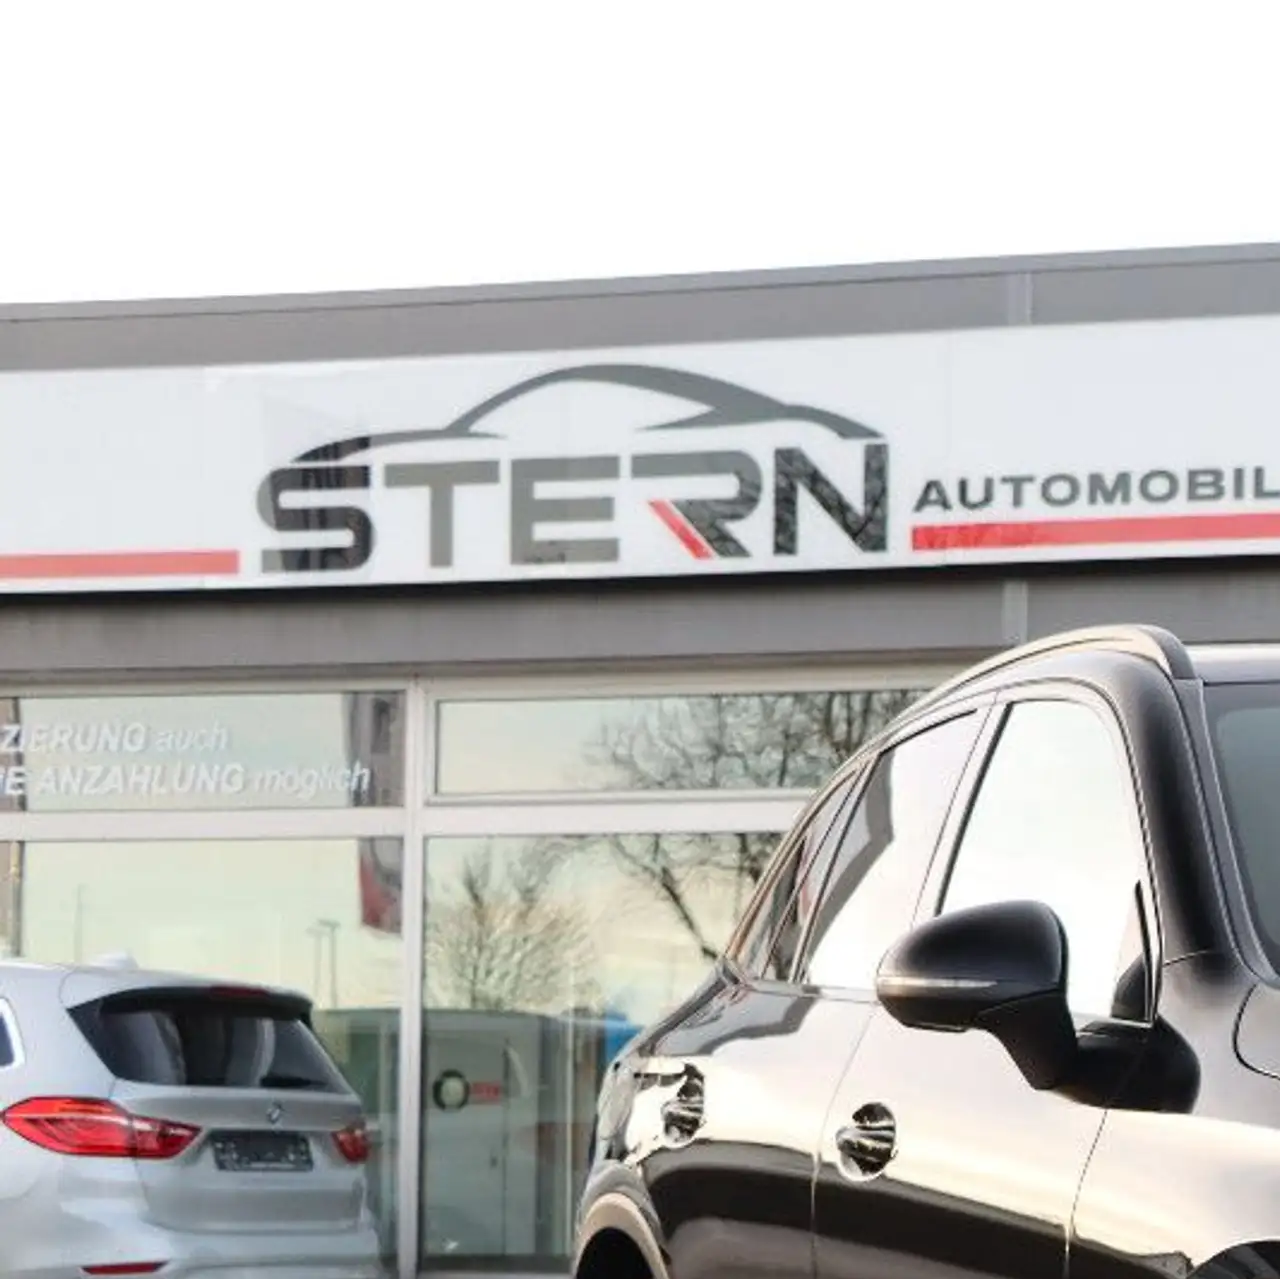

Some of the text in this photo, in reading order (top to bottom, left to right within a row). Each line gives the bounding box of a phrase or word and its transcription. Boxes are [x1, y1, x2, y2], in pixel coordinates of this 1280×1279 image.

[256, 442, 889, 574] STERN
[154, 718, 229, 752] auch
[35, 761, 245, 795] ANZAHLUNG
